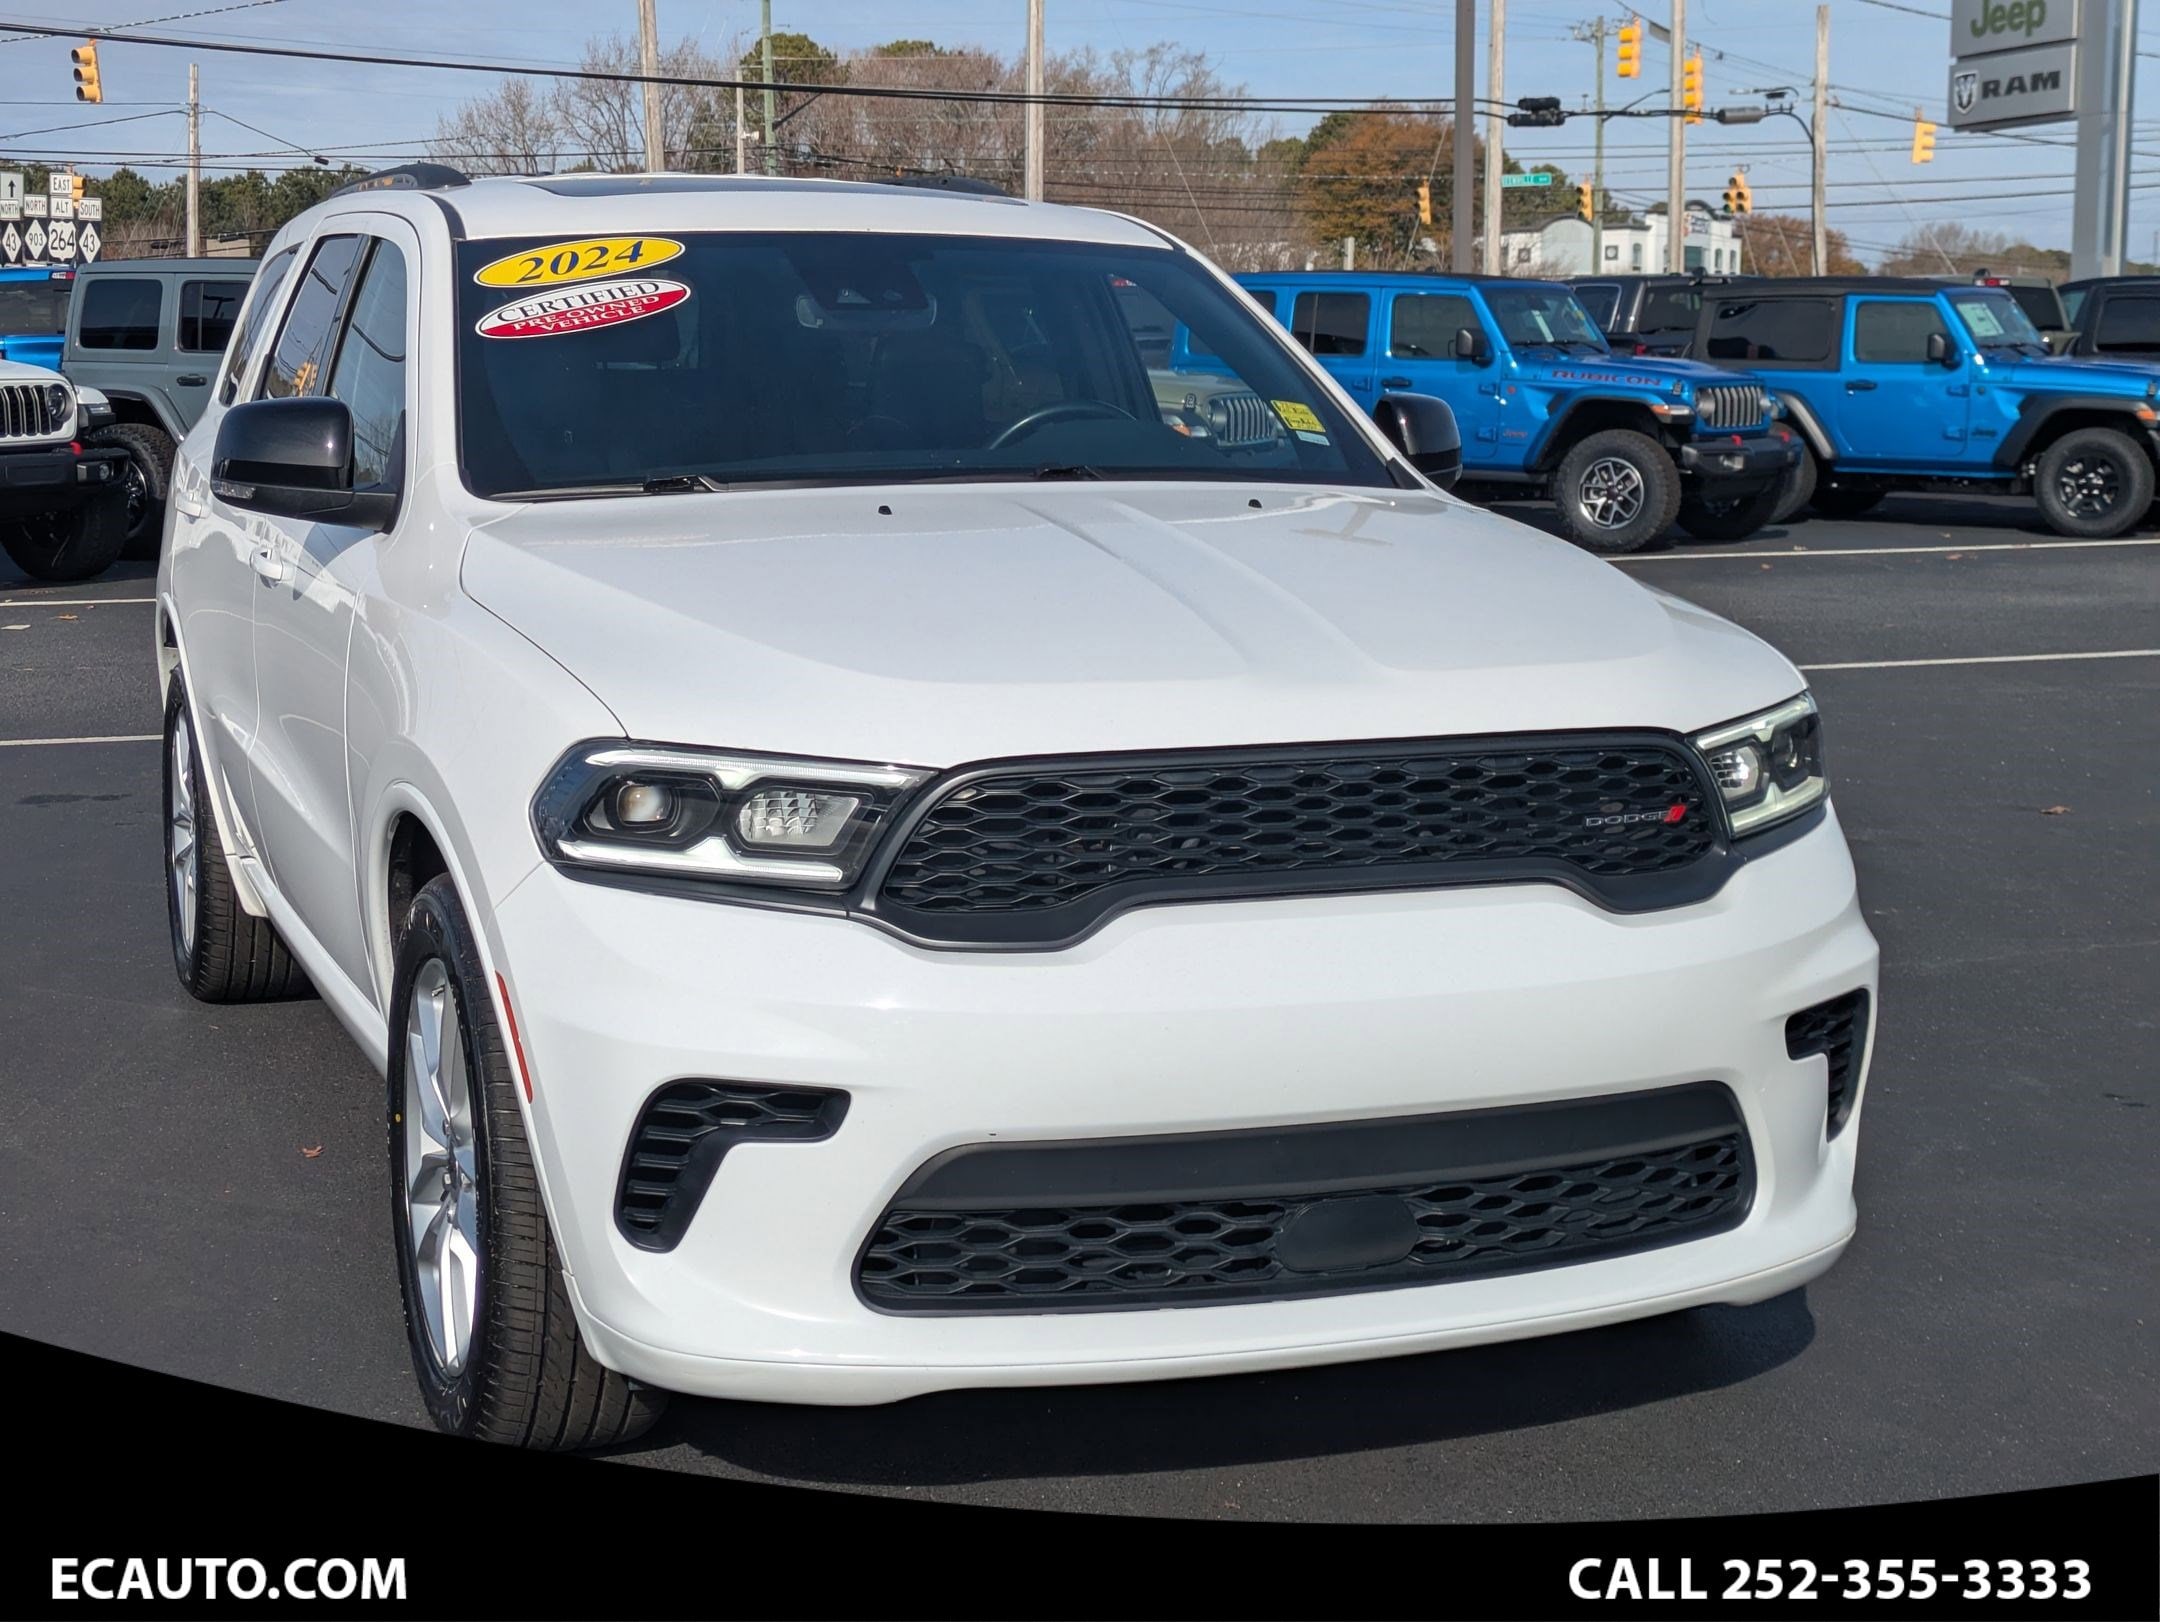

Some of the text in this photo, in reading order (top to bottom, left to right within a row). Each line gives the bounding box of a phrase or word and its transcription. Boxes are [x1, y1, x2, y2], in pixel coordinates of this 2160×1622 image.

[1970, 0, 2046, 38] Jeep
[1982, 71, 2061, 99] RAM
[53, 177, 70, 191] EAST
[1, 203, 19, 215] NORTH
[25, 200, 46, 211] NORTH
[55, 201, 69, 213] ALT
[80, 202, 100, 215] SOUTH
[5, 233, 17, 252] 43
[28, 233, 43, 246] 903
[50, 228, 75, 252] 264
[83, 234, 95, 253] 43
[516, 240, 643, 283] 2024
[497, 282, 660, 322] CERTIFIED
[512, 296, 660, 330] PRE-OWNED
[540, 306, 645, 331] VEHICLE
[1552, 370, 1662, 386] RUBICON
[1586, 810, 1669, 826] DODGE
